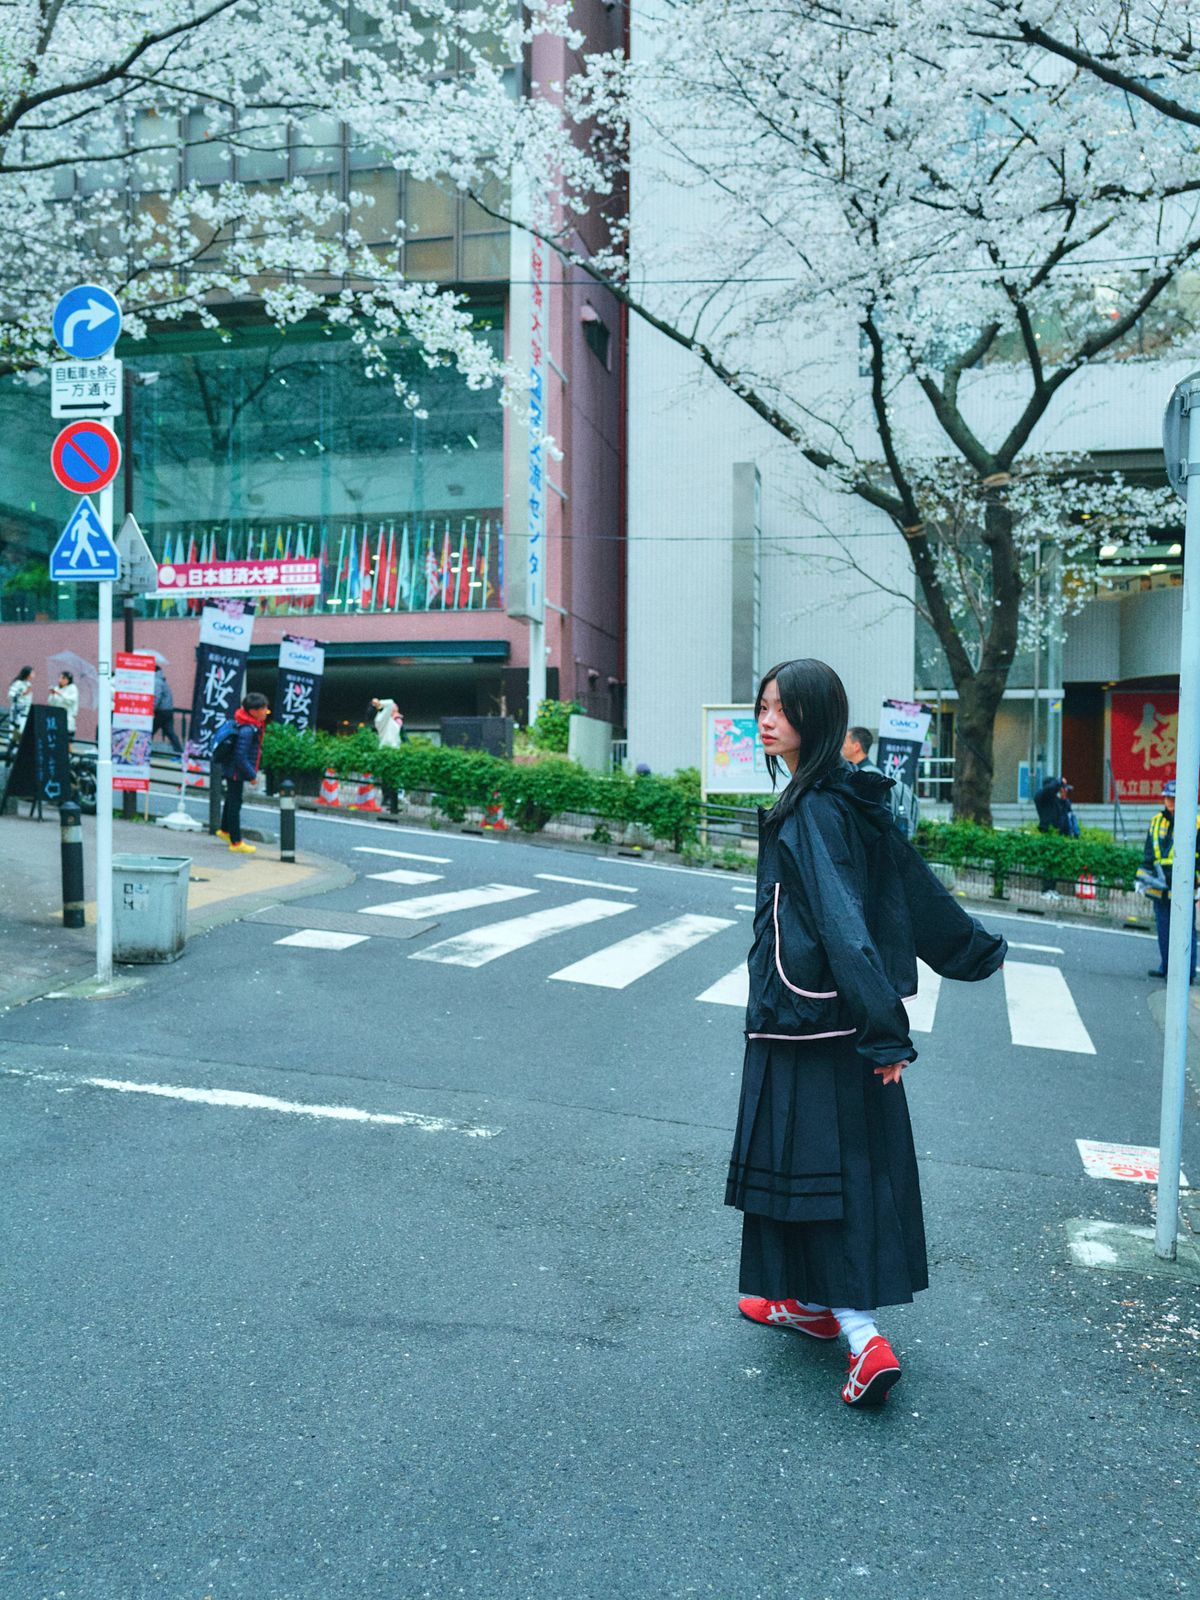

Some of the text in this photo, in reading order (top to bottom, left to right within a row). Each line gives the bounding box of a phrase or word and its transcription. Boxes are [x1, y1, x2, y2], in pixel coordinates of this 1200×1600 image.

[56, 366, 116, 380] 自転車を除く
[56, 382, 116, 397] 一方通行
[189, 566, 279, 586] 日本経済大学
[212, 621, 244, 635] GMO
[289, 651, 316, 662] GMO
[203, 664, 237, 709] 桜
[283, 682, 312, 715] 桜
[890, 719, 919, 729] GMO
